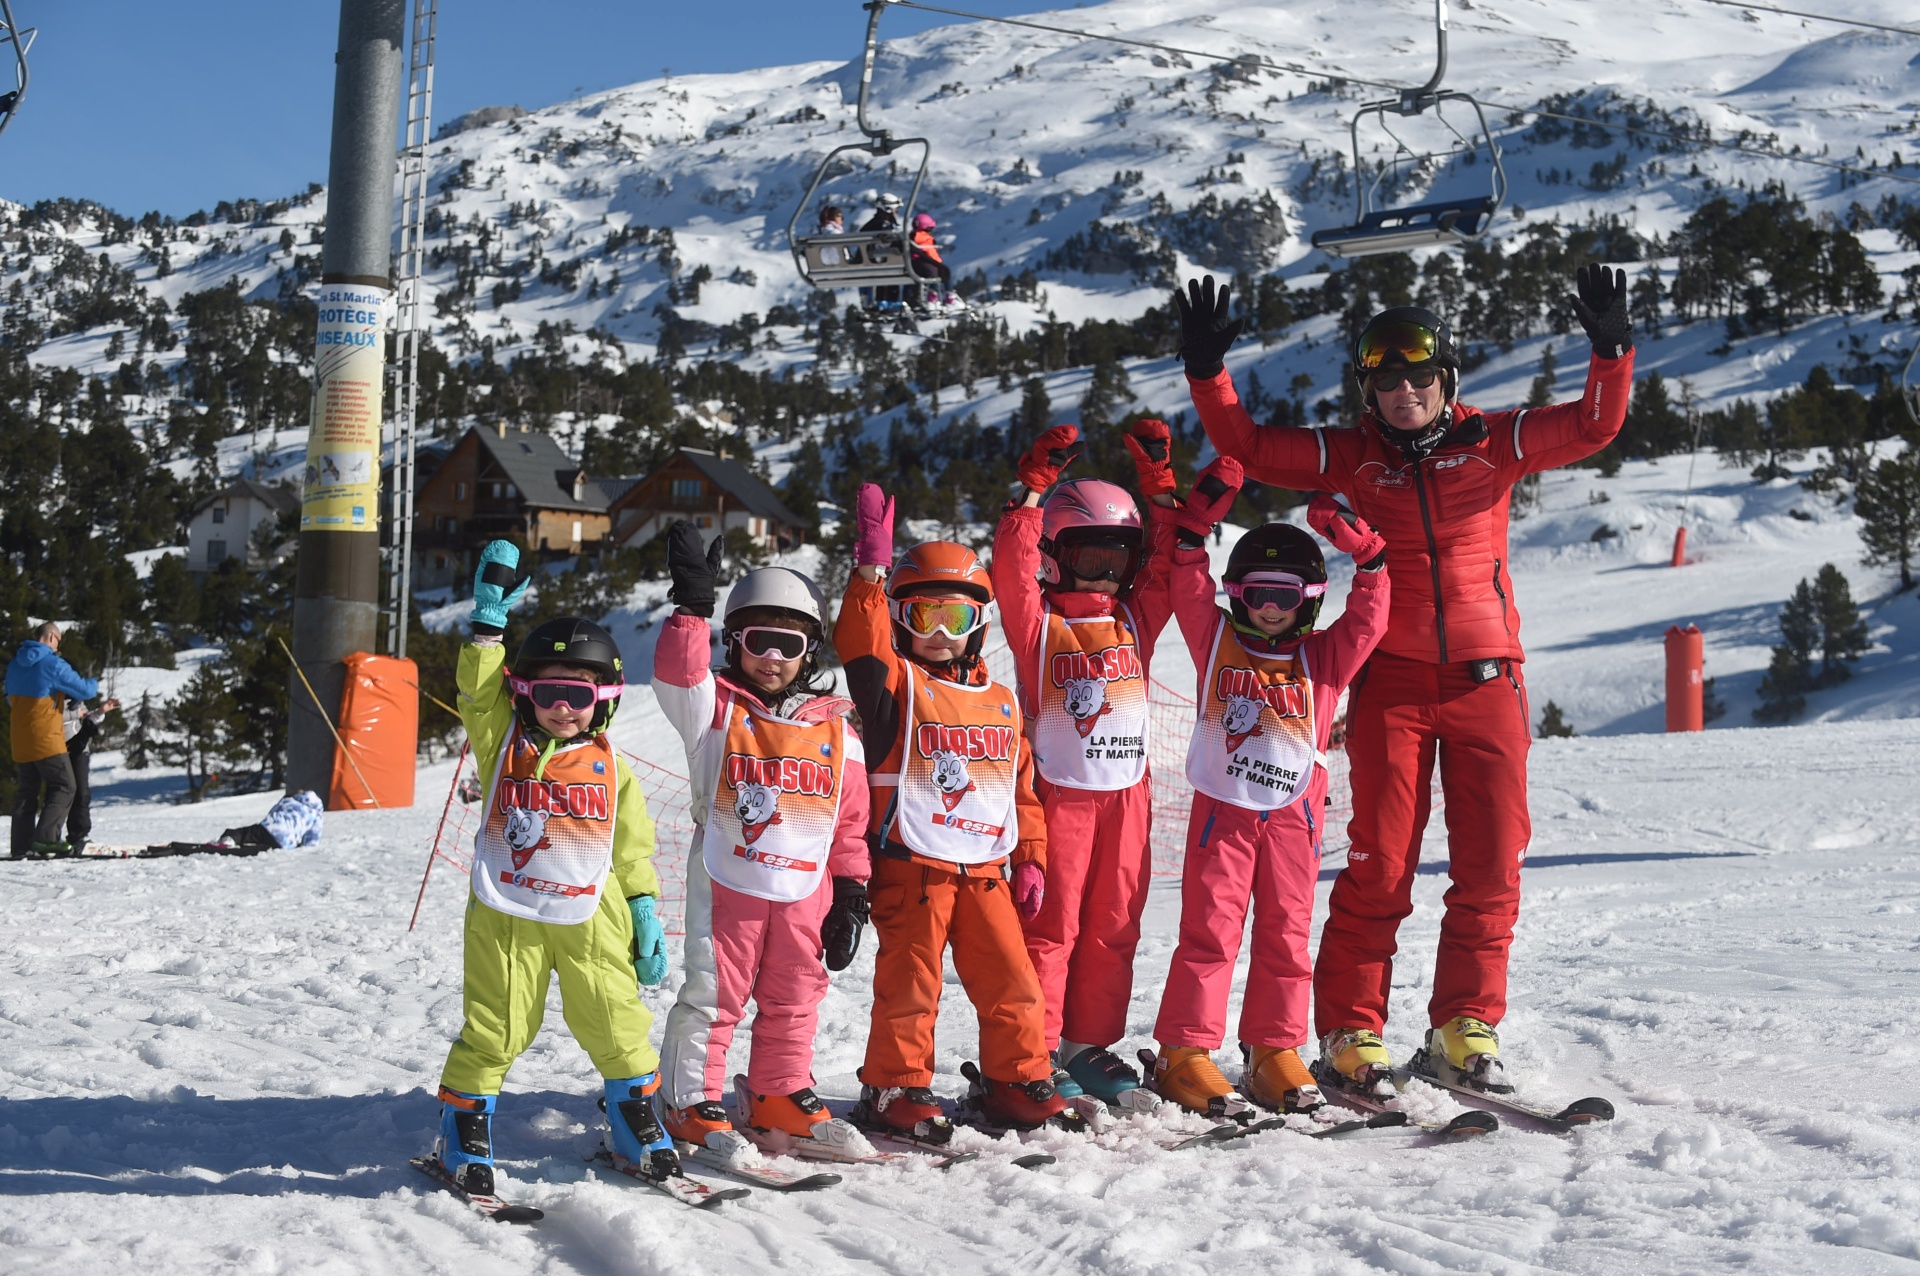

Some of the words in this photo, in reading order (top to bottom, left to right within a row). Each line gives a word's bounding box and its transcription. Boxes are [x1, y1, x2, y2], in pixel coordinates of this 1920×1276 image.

[329, 292, 341, 302] St
[343, 292, 381, 305] Martin
[319, 304, 376, 325] ROTÈGE
[1216, 665, 1308, 718] OURON
[1085, 749, 1102, 759] ST
[1106, 748, 1145, 759] MARTIN
[1090, 736, 1106, 746] LA
[1110, 736, 1143, 746] PIERRE
[725, 752, 836, 799] OURSON
[1226, 765, 1243, 777] ST
[1245, 771, 1295, 794] MARTIN
[1232, 753, 1249, 767] LA
[1252, 759, 1299, 782] PIERRE
